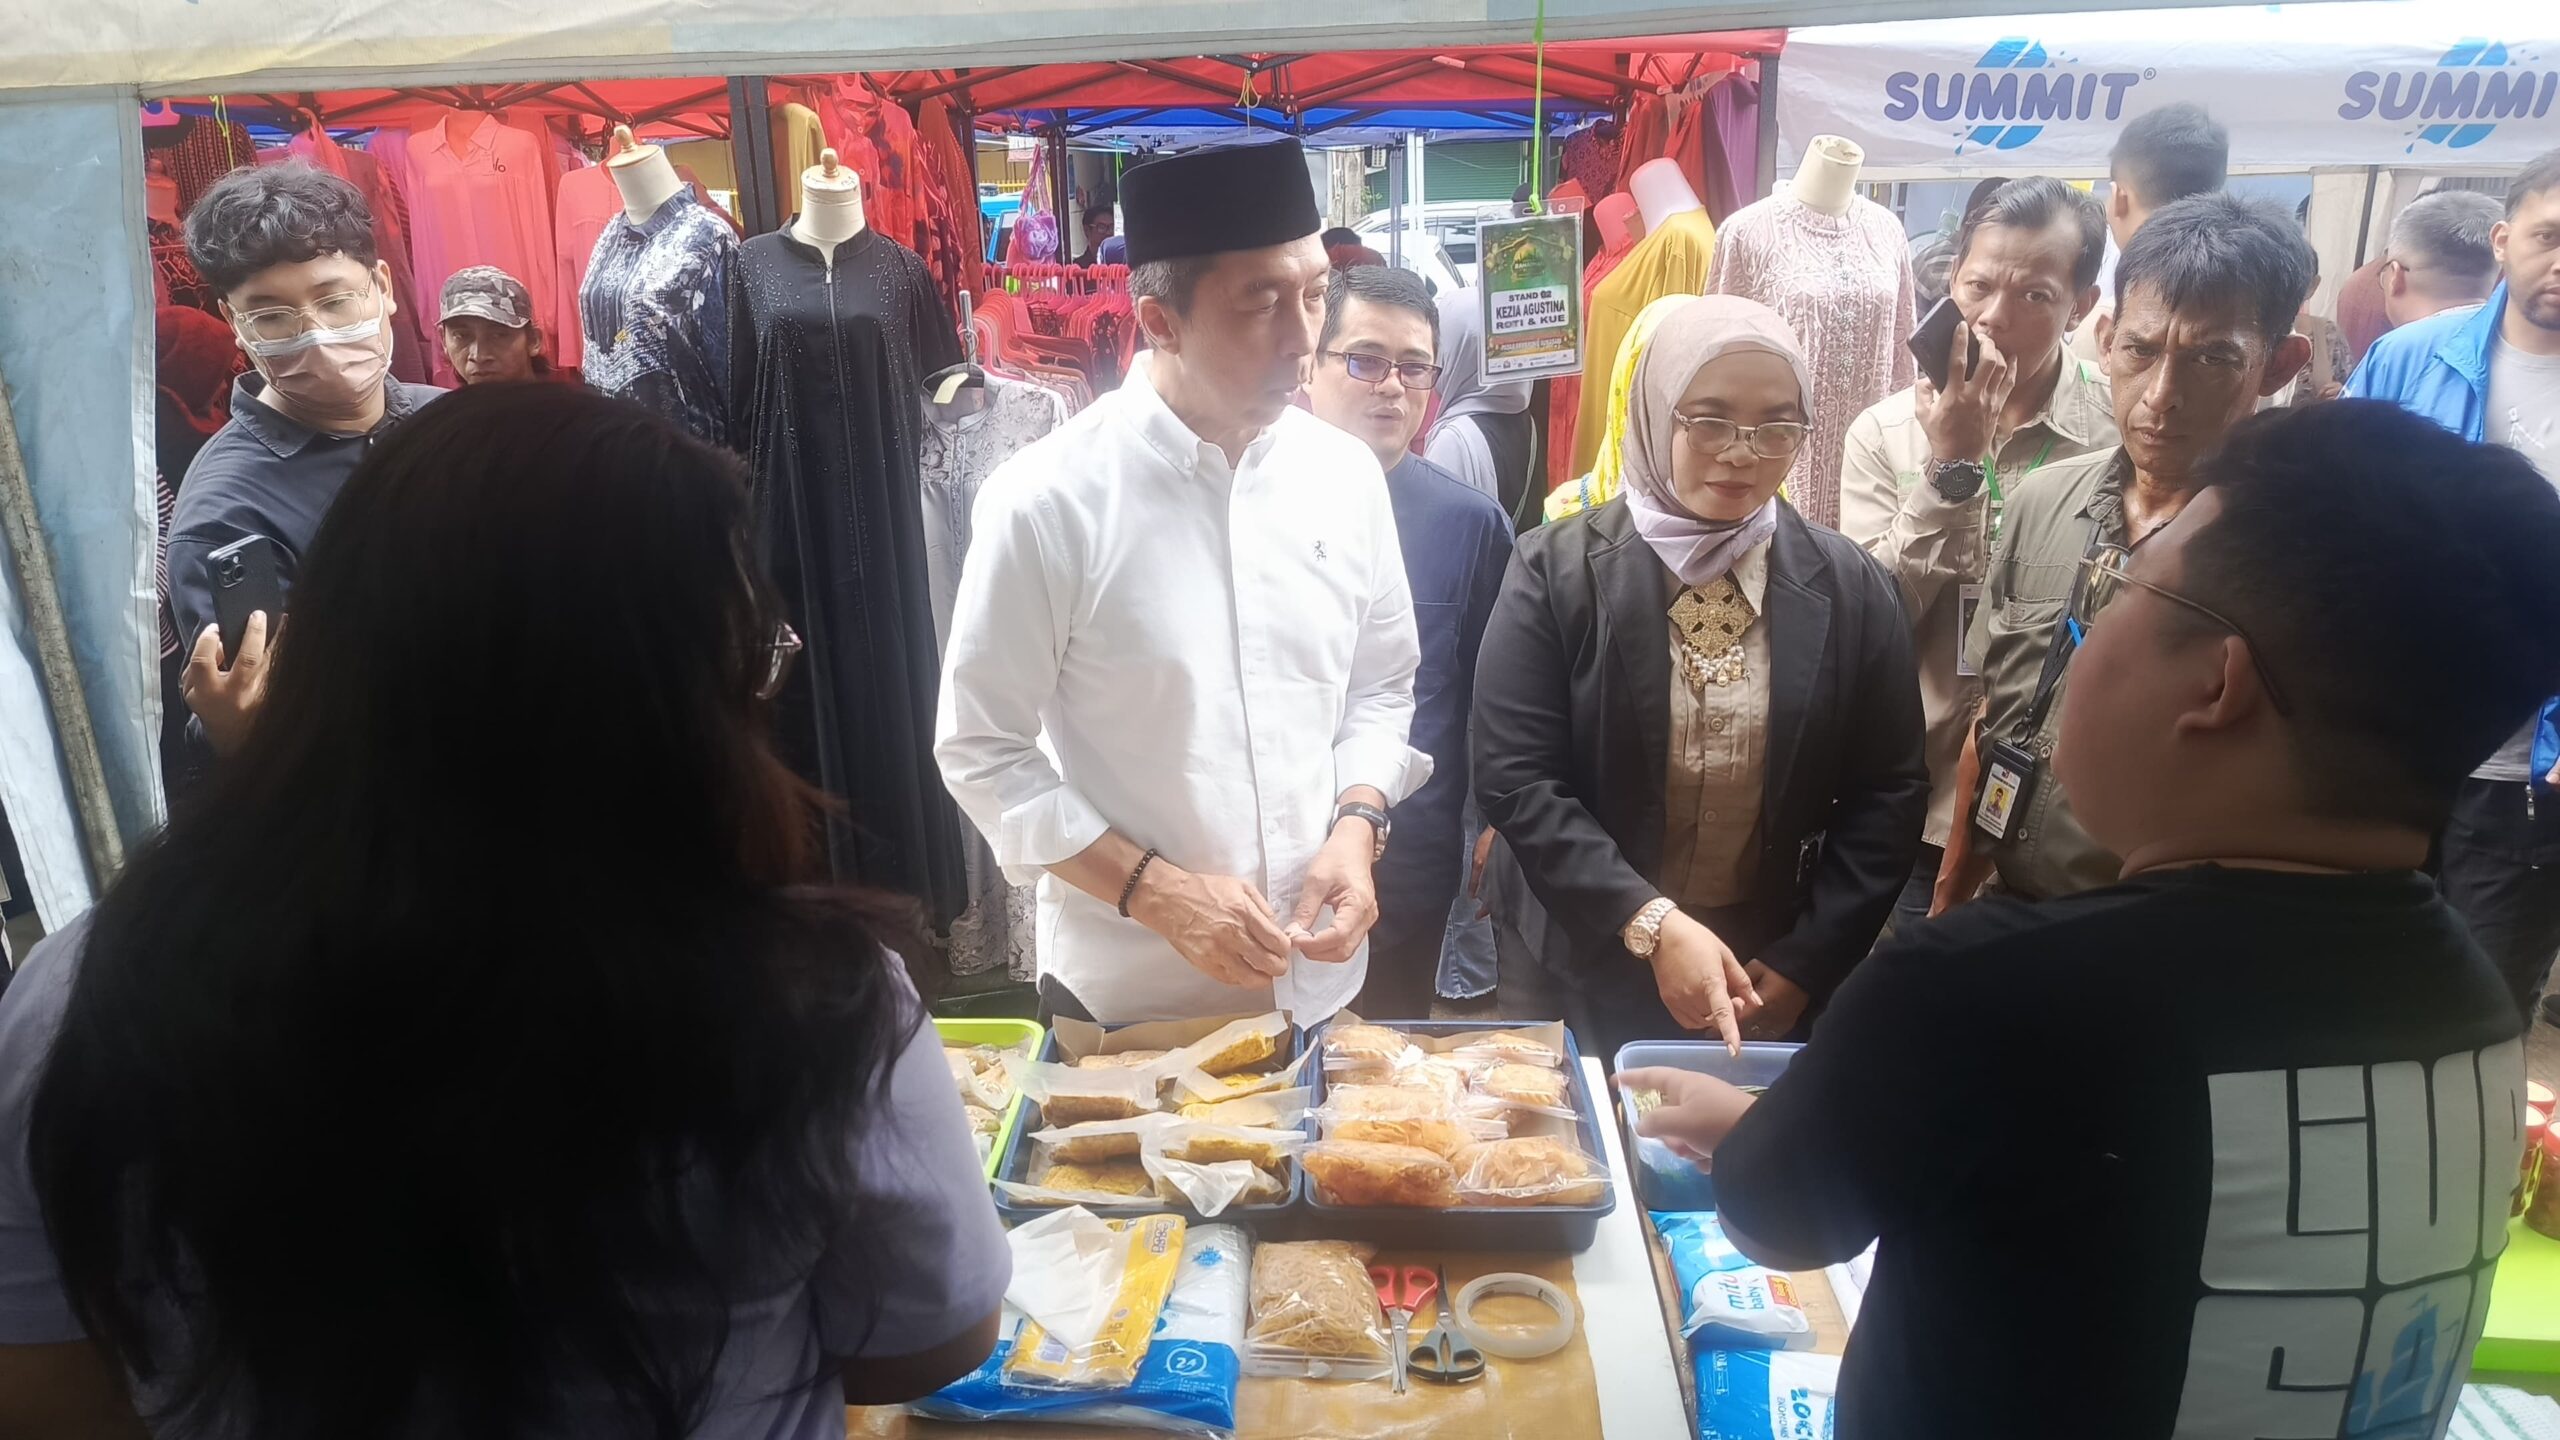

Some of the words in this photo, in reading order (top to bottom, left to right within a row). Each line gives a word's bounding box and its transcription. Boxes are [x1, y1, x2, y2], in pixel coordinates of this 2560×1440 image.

[1884, 71, 2140, 122] SUMMIT
[2337, 71, 2559, 121] SUMMI
[1496, 304, 1521, 320] KEZIA
[1523, 299, 1566, 317] AGUSTINA
[1508, 292, 1539, 302] STAND
[1496, 319, 1524, 330] ROTI
[1540, 314, 1566, 325] KUE
[1718, 1273, 1746, 1310] mitu
[1746, 1285, 1765, 1310] baby
